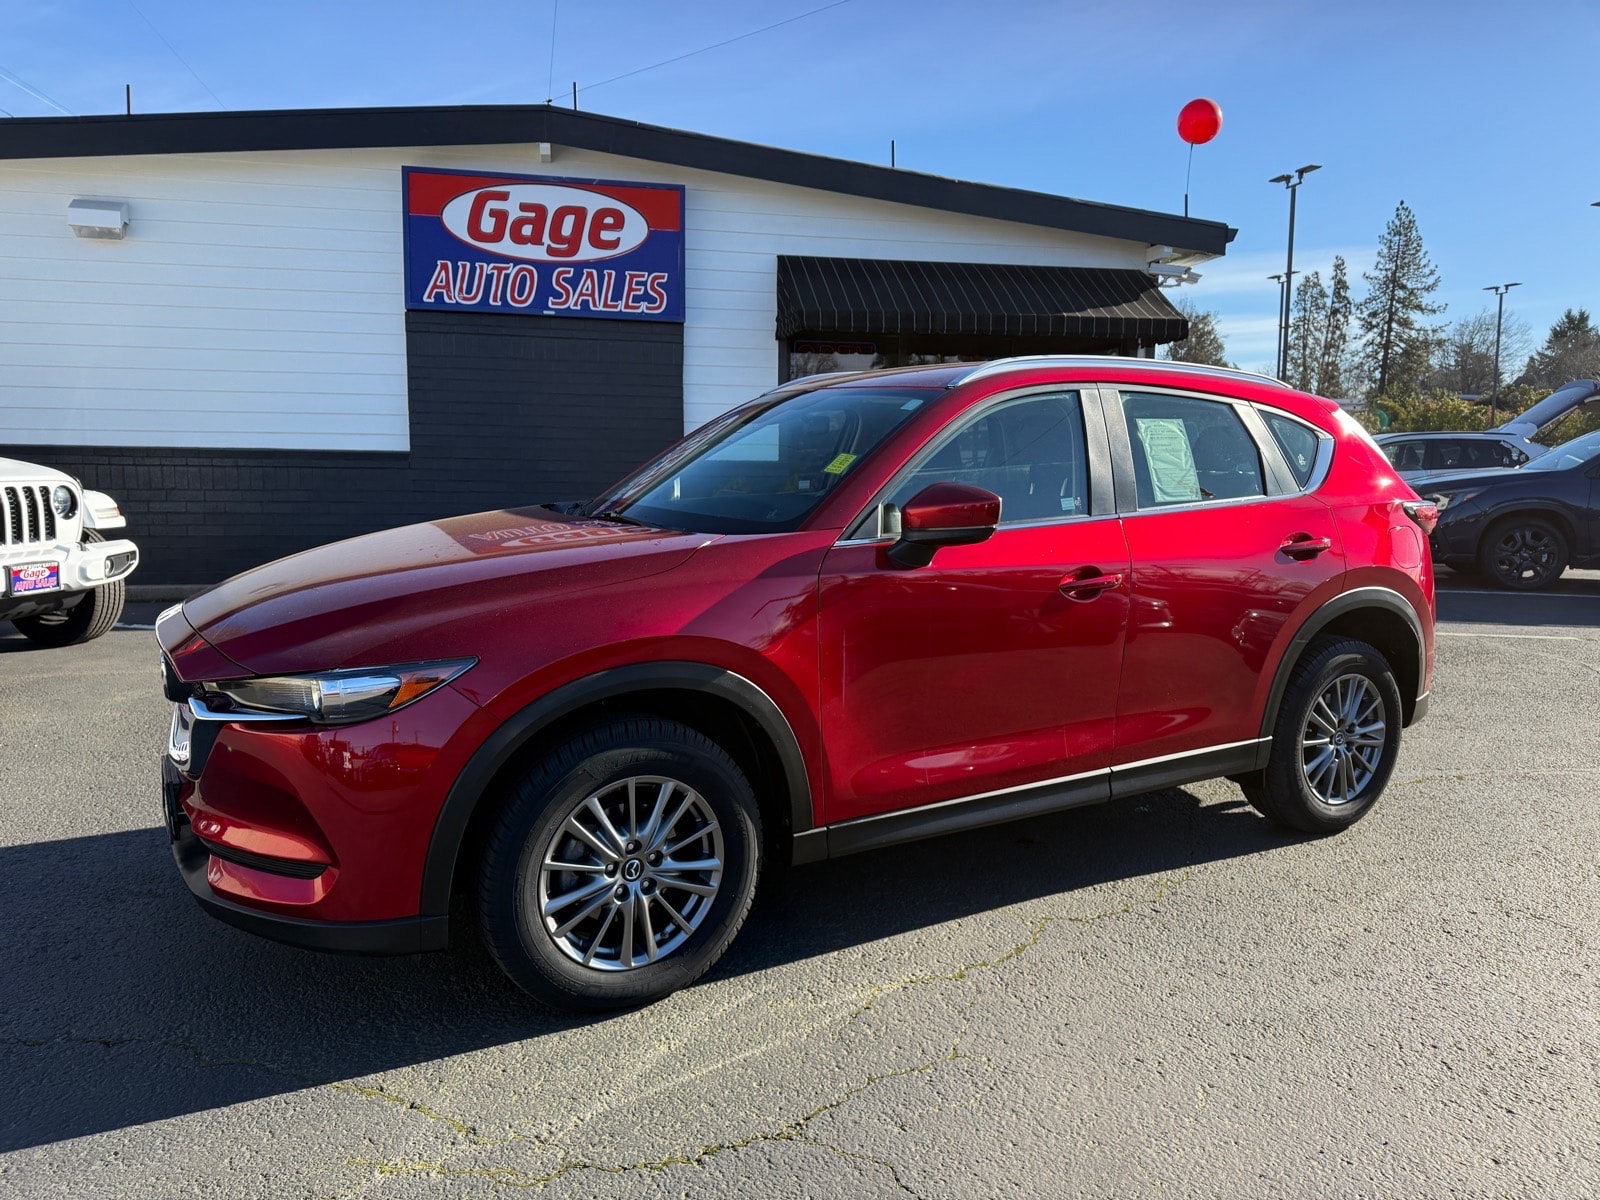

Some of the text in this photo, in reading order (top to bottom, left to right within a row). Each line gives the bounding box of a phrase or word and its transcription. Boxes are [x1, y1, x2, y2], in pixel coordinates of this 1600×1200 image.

[467, 190, 625, 257] Gage
[423, 260, 668, 313] AUTO SALES
[23, 568, 46, 579] Gage
